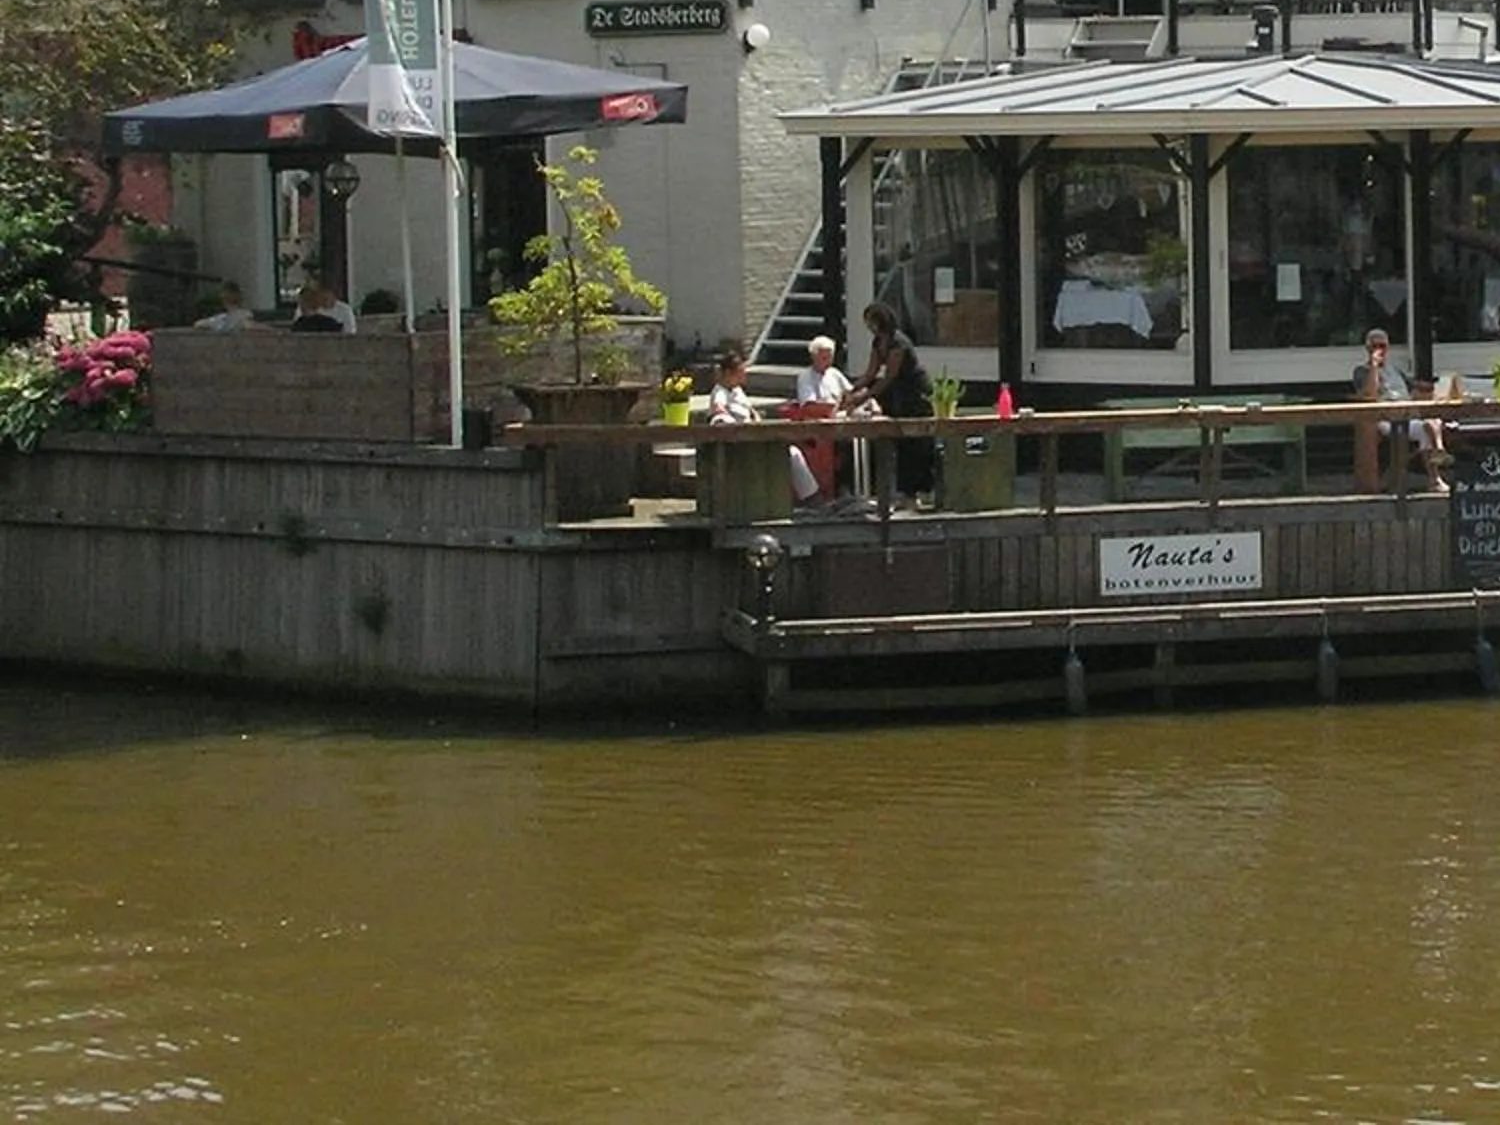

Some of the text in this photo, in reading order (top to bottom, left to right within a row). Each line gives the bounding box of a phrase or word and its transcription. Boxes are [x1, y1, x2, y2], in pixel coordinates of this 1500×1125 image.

[592, 8, 614, 27] De
[1474, 520, 1497, 537] en
[1128, 539, 1234, 570] Nauta's
[1105, 574, 1257, 590] botenverhuur
